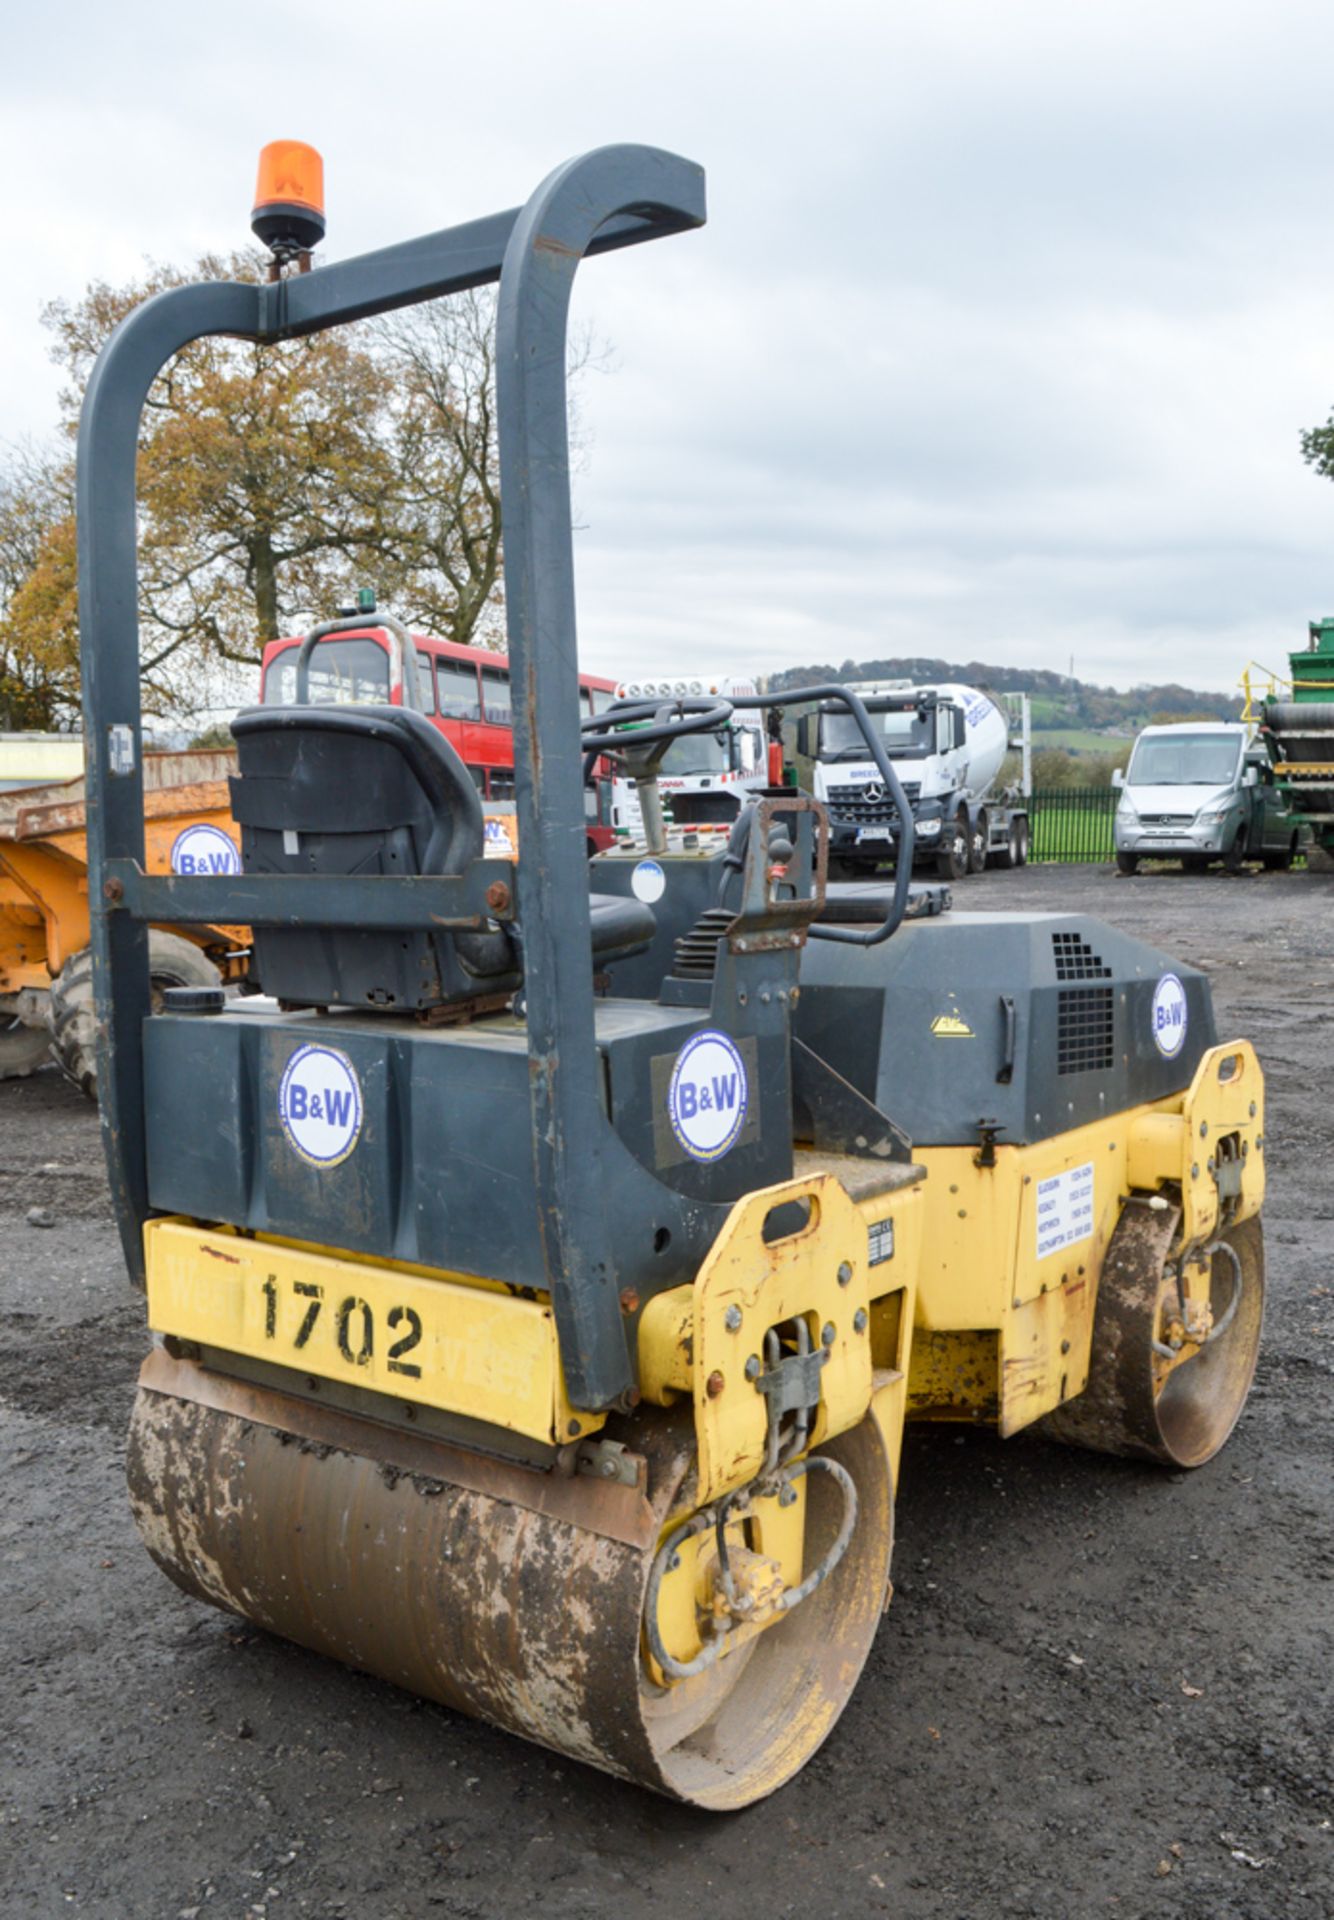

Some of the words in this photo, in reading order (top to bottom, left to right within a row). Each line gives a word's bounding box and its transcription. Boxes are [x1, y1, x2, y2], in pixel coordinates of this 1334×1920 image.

[655, 780, 686, 788] CANIA
[180, 852, 231, 875] B&W
[1157, 1002, 1182, 1030] B&W
[289, 1083, 352, 1128] B&W
[679, 1073, 737, 1121] B&W
[262, 1273, 423, 1380] 1702
